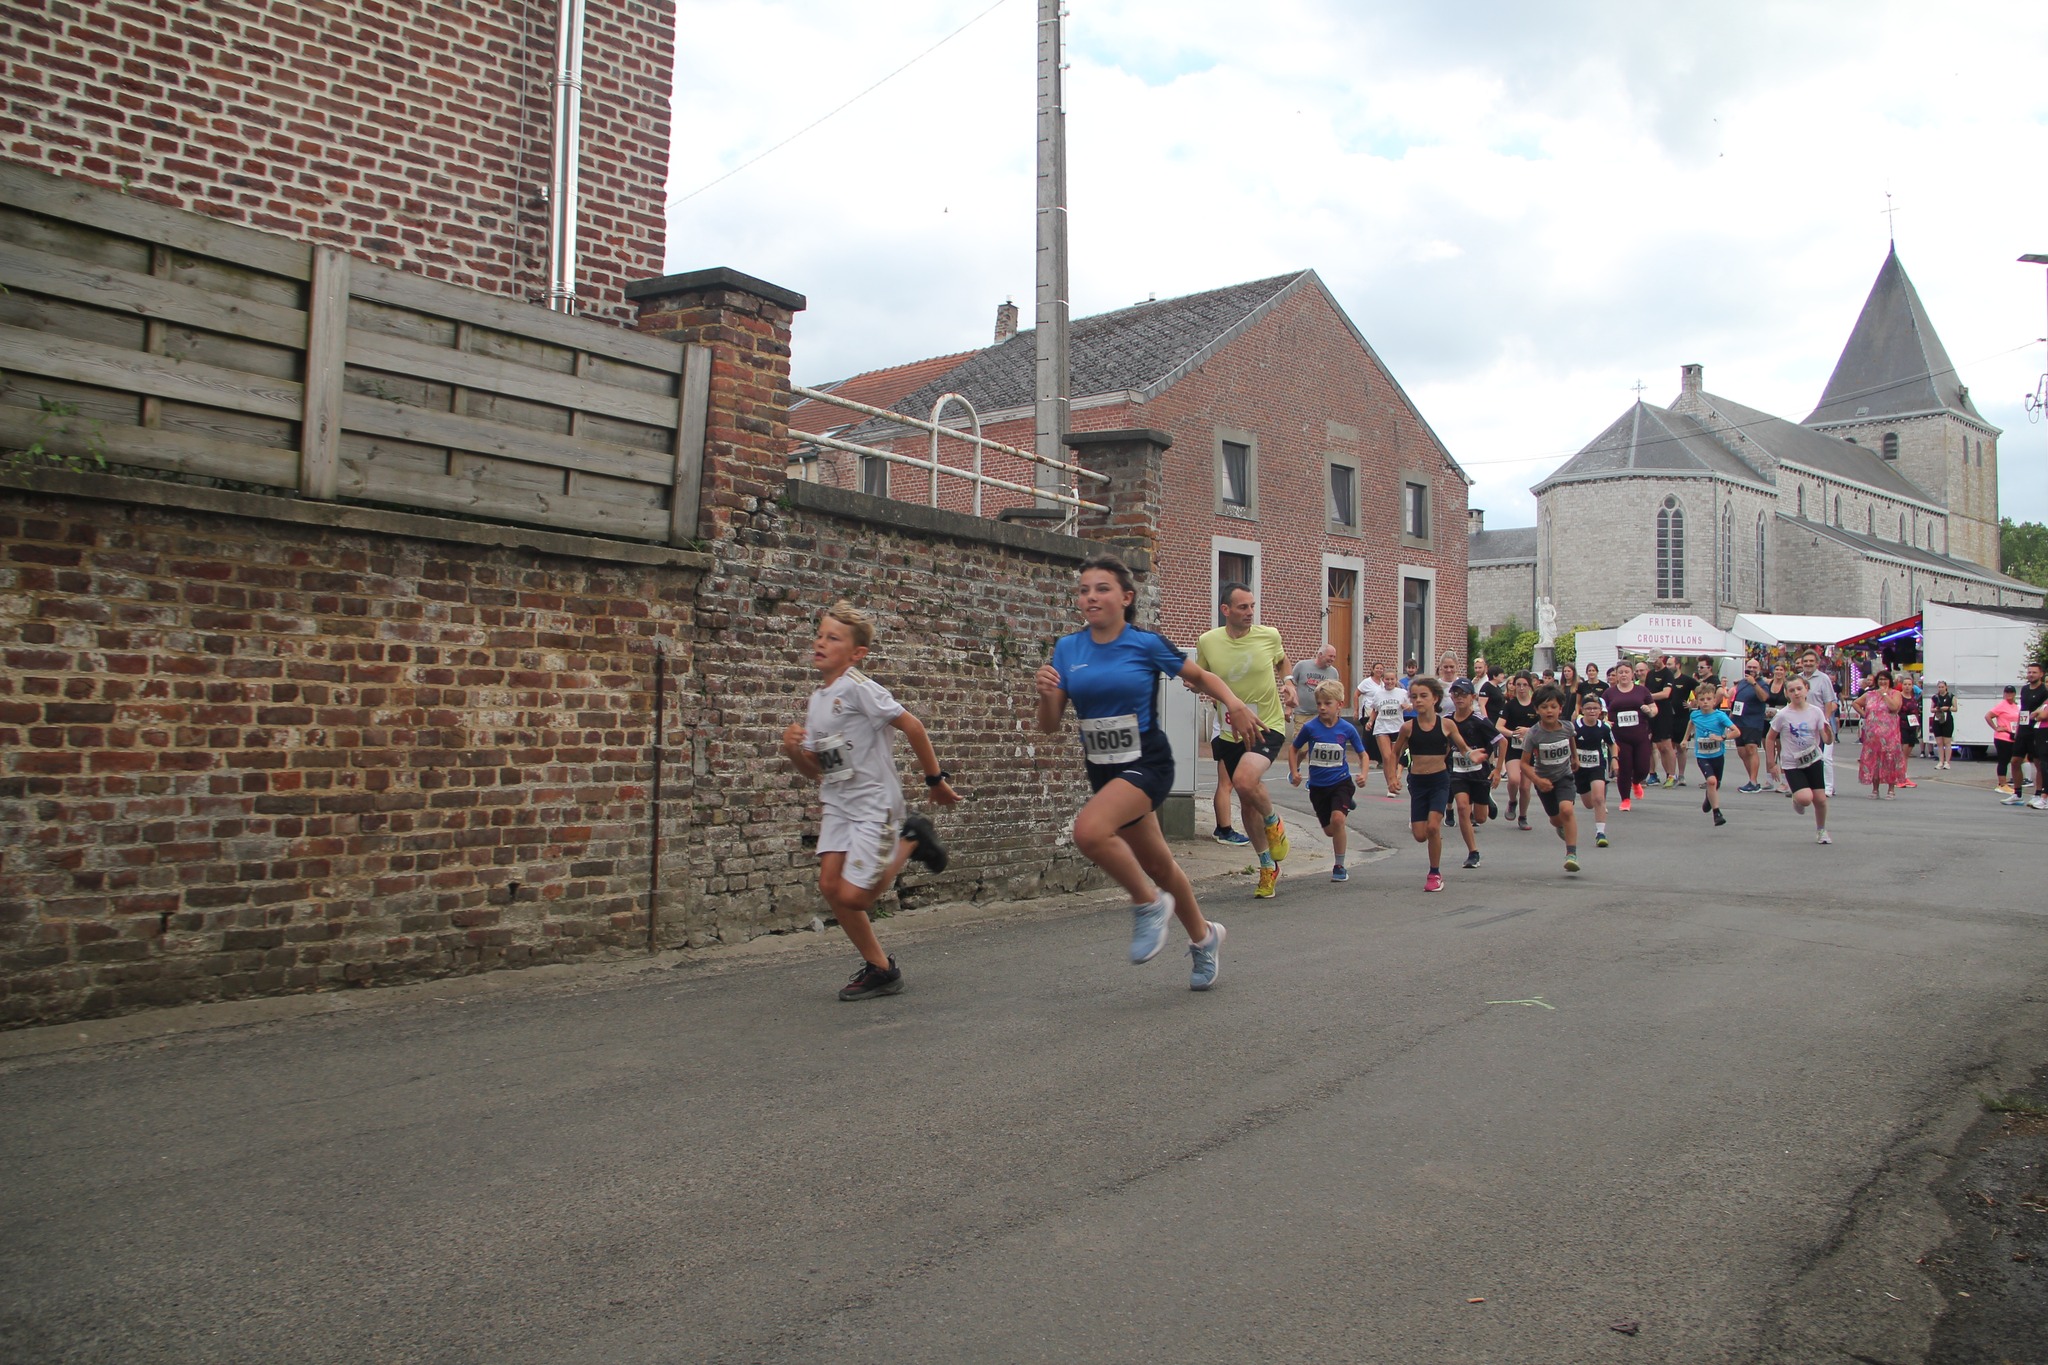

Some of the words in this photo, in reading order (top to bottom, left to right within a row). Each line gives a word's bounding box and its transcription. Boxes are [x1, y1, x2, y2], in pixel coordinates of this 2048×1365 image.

[1649, 617, 1693, 628] FRITERIE
[1637, 634, 1703, 645] CROUSTILLONS
[1619, 715, 1637, 723] 1611
[1087, 729, 1133, 750] 1605
[1698, 741, 1718, 750] 1601
[1314, 749, 1341, 761] 1610
[1543, 745, 1569, 759] 1606
[1798, 749, 1817, 765] 1613
[1578, 754, 1598, 763] 1625
